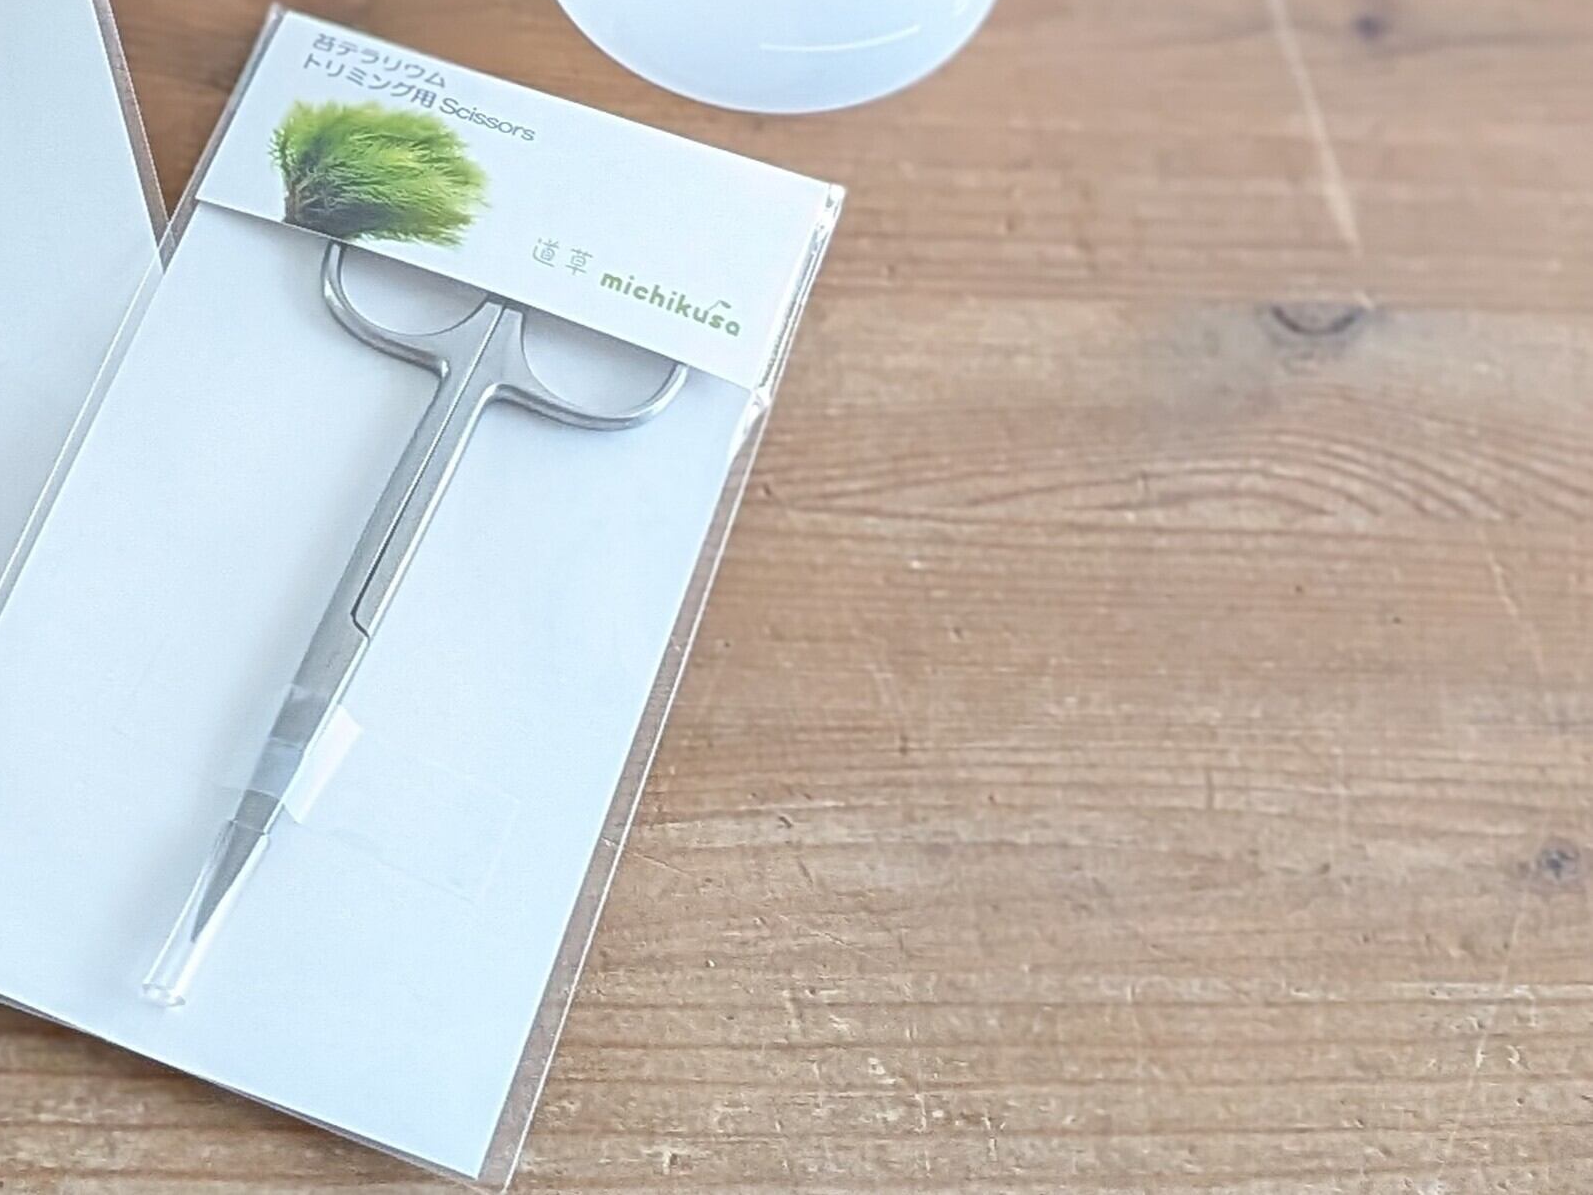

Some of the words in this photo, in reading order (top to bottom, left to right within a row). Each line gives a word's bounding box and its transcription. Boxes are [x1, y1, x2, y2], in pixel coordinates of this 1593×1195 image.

[303, 53, 437, 109] トリミング用
[439, 97, 536, 142] Scissors
[312, 33, 447, 88] 苔テラリウム
[532, 238, 593, 276] 道草
[600, 271, 741, 337] michikusa
